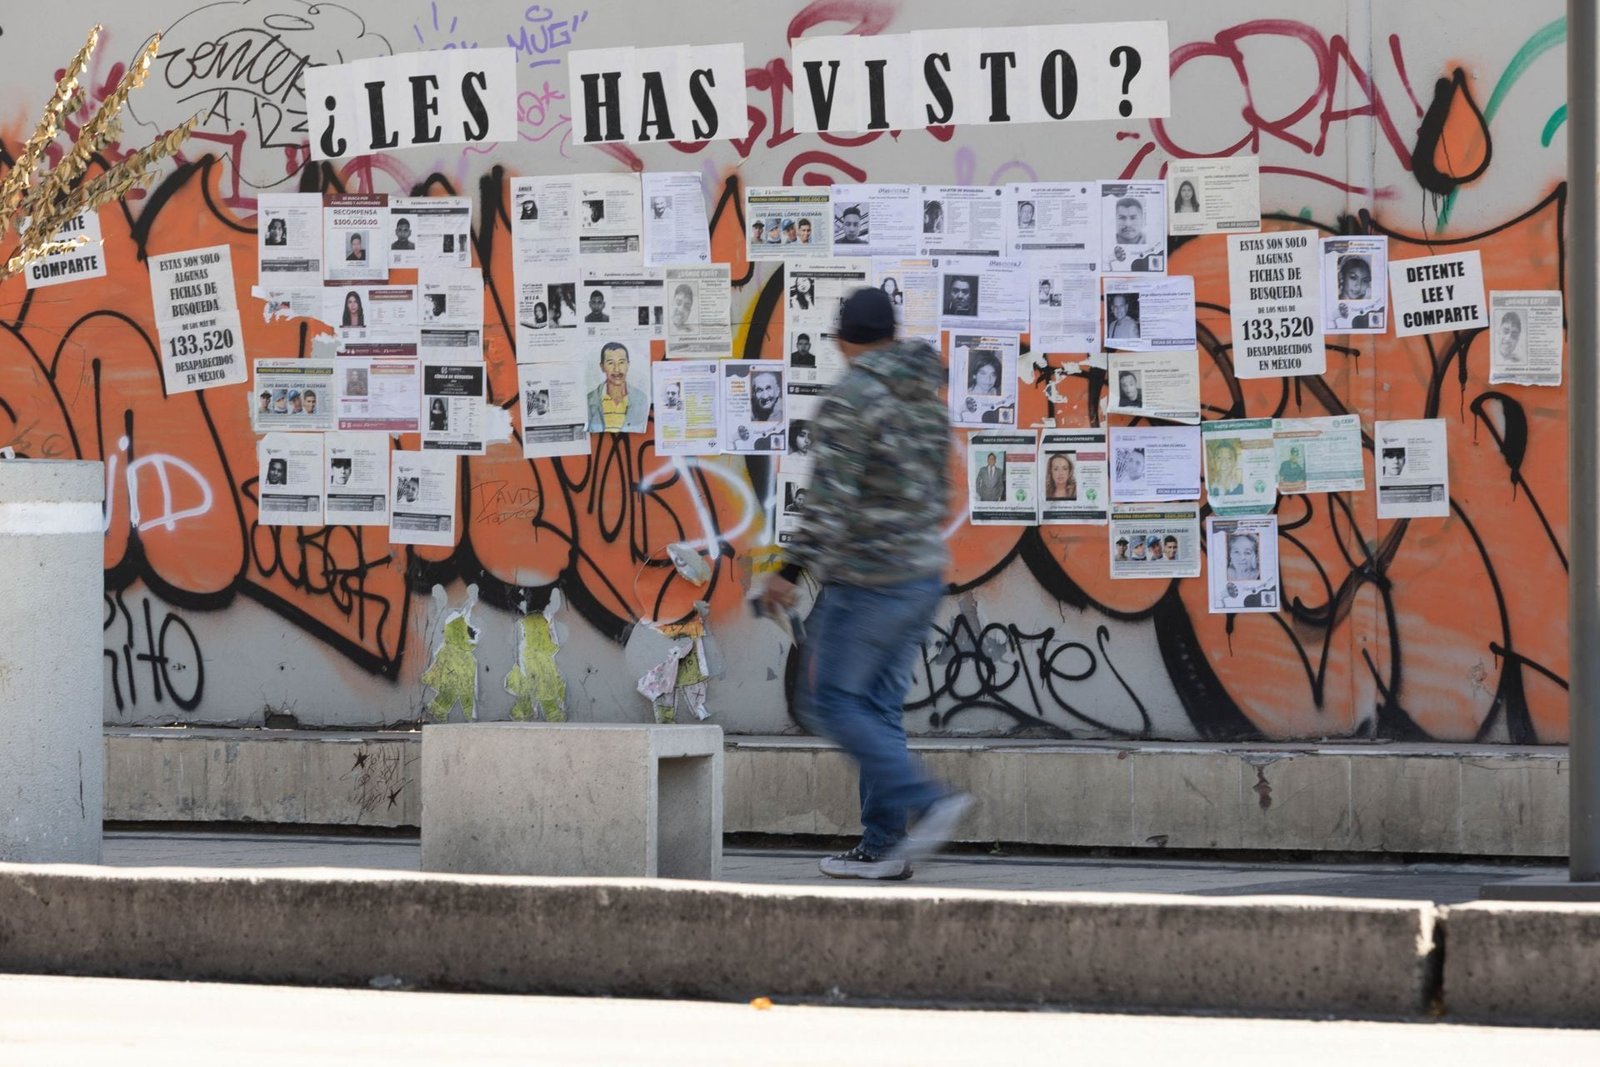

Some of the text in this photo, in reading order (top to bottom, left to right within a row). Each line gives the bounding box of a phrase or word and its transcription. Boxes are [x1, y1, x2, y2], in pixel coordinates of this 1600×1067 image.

[319, 71, 490, 157] ¿LES
[580, 68, 720, 142] HAS
[802, 46, 1142, 131] VISTO?
[1240, 237, 1307, 251] ESTAS SON SOLO
[160, 253, 220, 272] ESTAS SON SOLO
[1256, 252, 1293, 265] ALGUNAS
[32, 256, 98, 280] COMPARTE
[175, 269, 209, 282] ALGUNAS
[1250, 268, 1302, 282] FICHAS DE
[1406, 261, 1464, 283] DETENTE
[170, 282, 218, 300] FICHAS DE
[1250, 285, 1302, 300] BUSQUEDA
[1422, 285, 1454, 303] LEE Y
[172, 299, 220, 318] BUSQUEDA
[1266, 306, 1276, 314] LOS
[1403, 305, 1479, 328] COMPARTE
[1242, 316, 1314, 341] 133,520
[169, 328, 234, 358] 133,520
[1247, 344, 1312, 357] DESAPARECIDOS
[175, 354, 234, 372] DESAPARECIDOS
[1259, 356, 1302, 371] EN MÉXICO
[187, 374, 196, 384] EN
